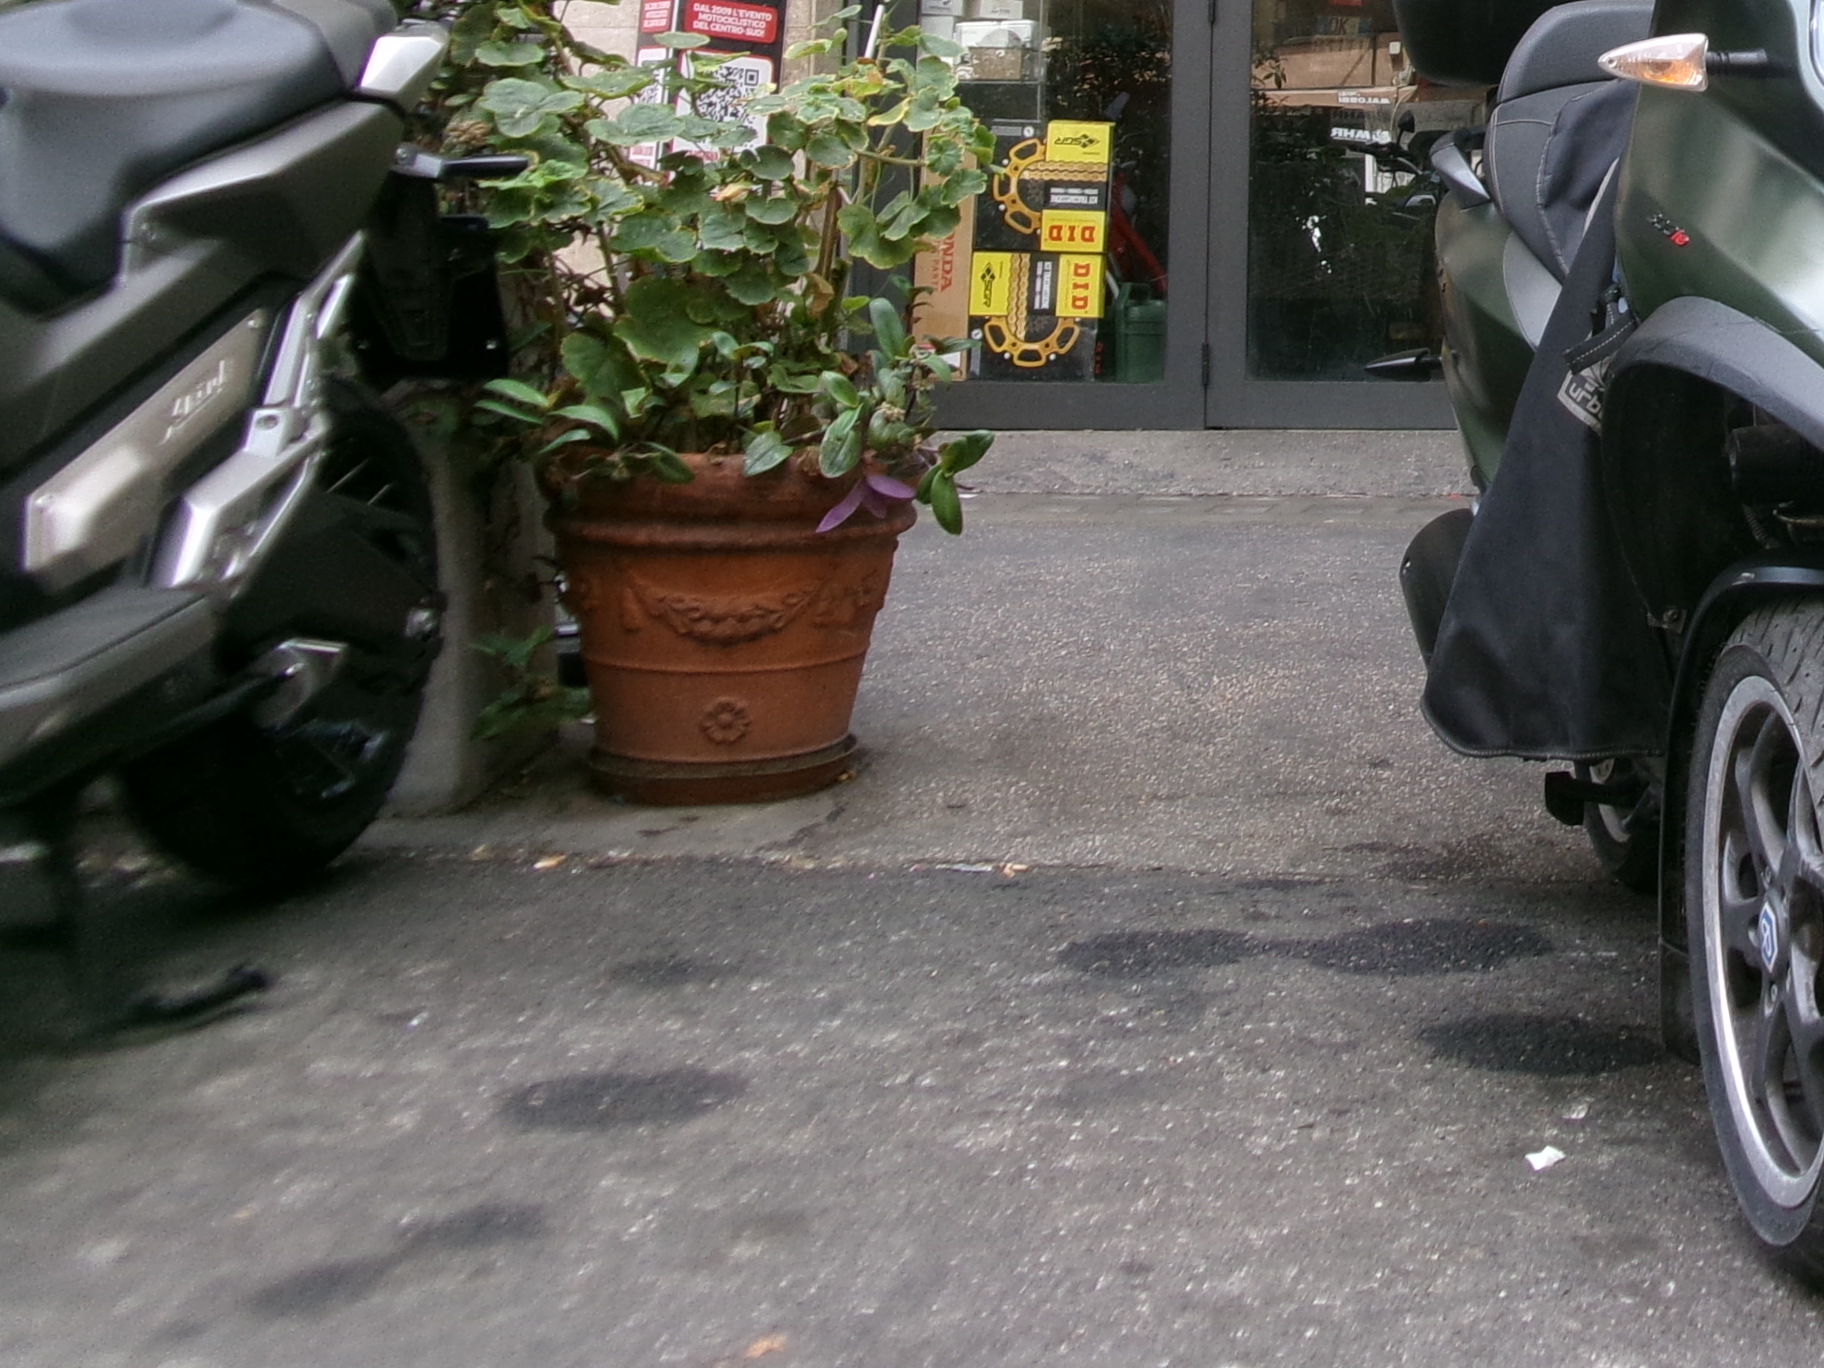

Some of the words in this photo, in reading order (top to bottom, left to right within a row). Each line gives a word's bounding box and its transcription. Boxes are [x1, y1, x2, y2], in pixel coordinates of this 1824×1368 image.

[693, 3, 710, 13] DAL
[733, 8, 772, 21] L'EVENTO
[693, 20, 709, 31] DEL
[697, 13, 766, 29] MOTOCICLISTICO
